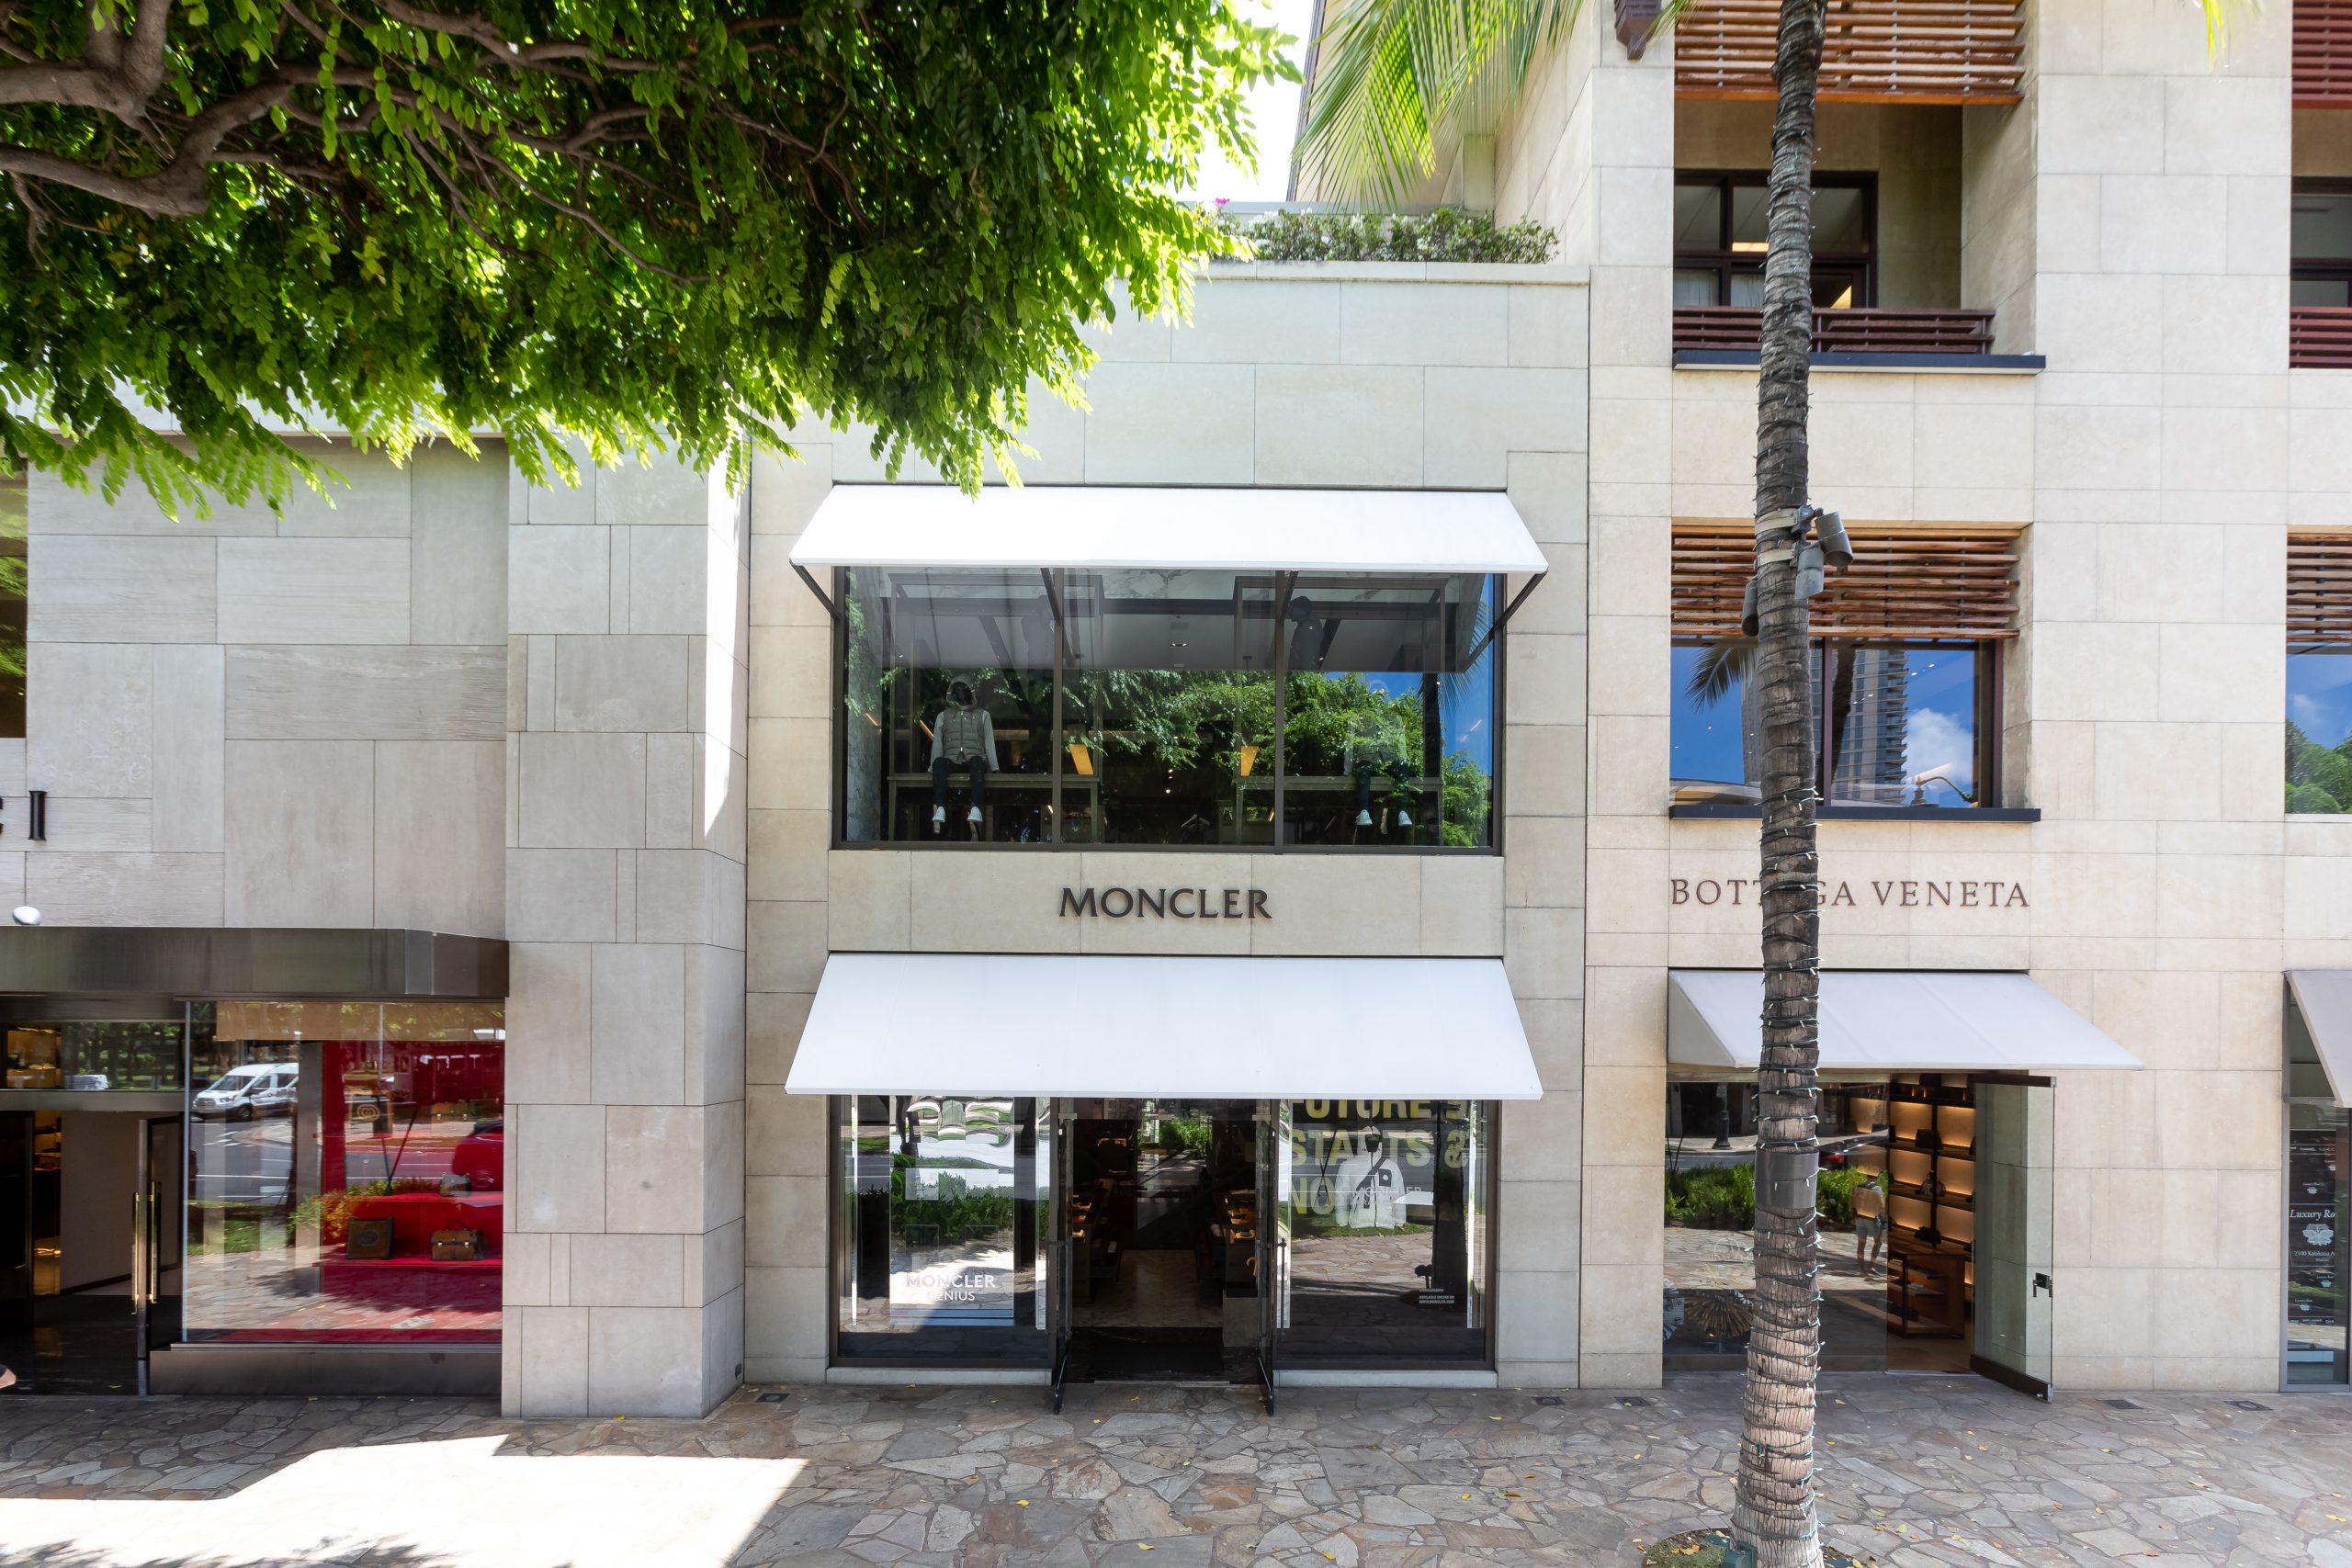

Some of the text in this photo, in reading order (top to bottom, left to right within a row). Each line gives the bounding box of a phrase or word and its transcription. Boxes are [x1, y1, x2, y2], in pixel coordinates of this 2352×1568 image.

[1059, 887, 1273, 919] MONCLER
[1671, 879, 2030, 907] BOTA VENETA
[1292, 1100, 1432, 1119] UTURE
[1292, 1129, 1430, 1167] STATS
[2290, 1209, 2321, 1221] Luxury
[906, 1274, 995, 1288] MONCLER
